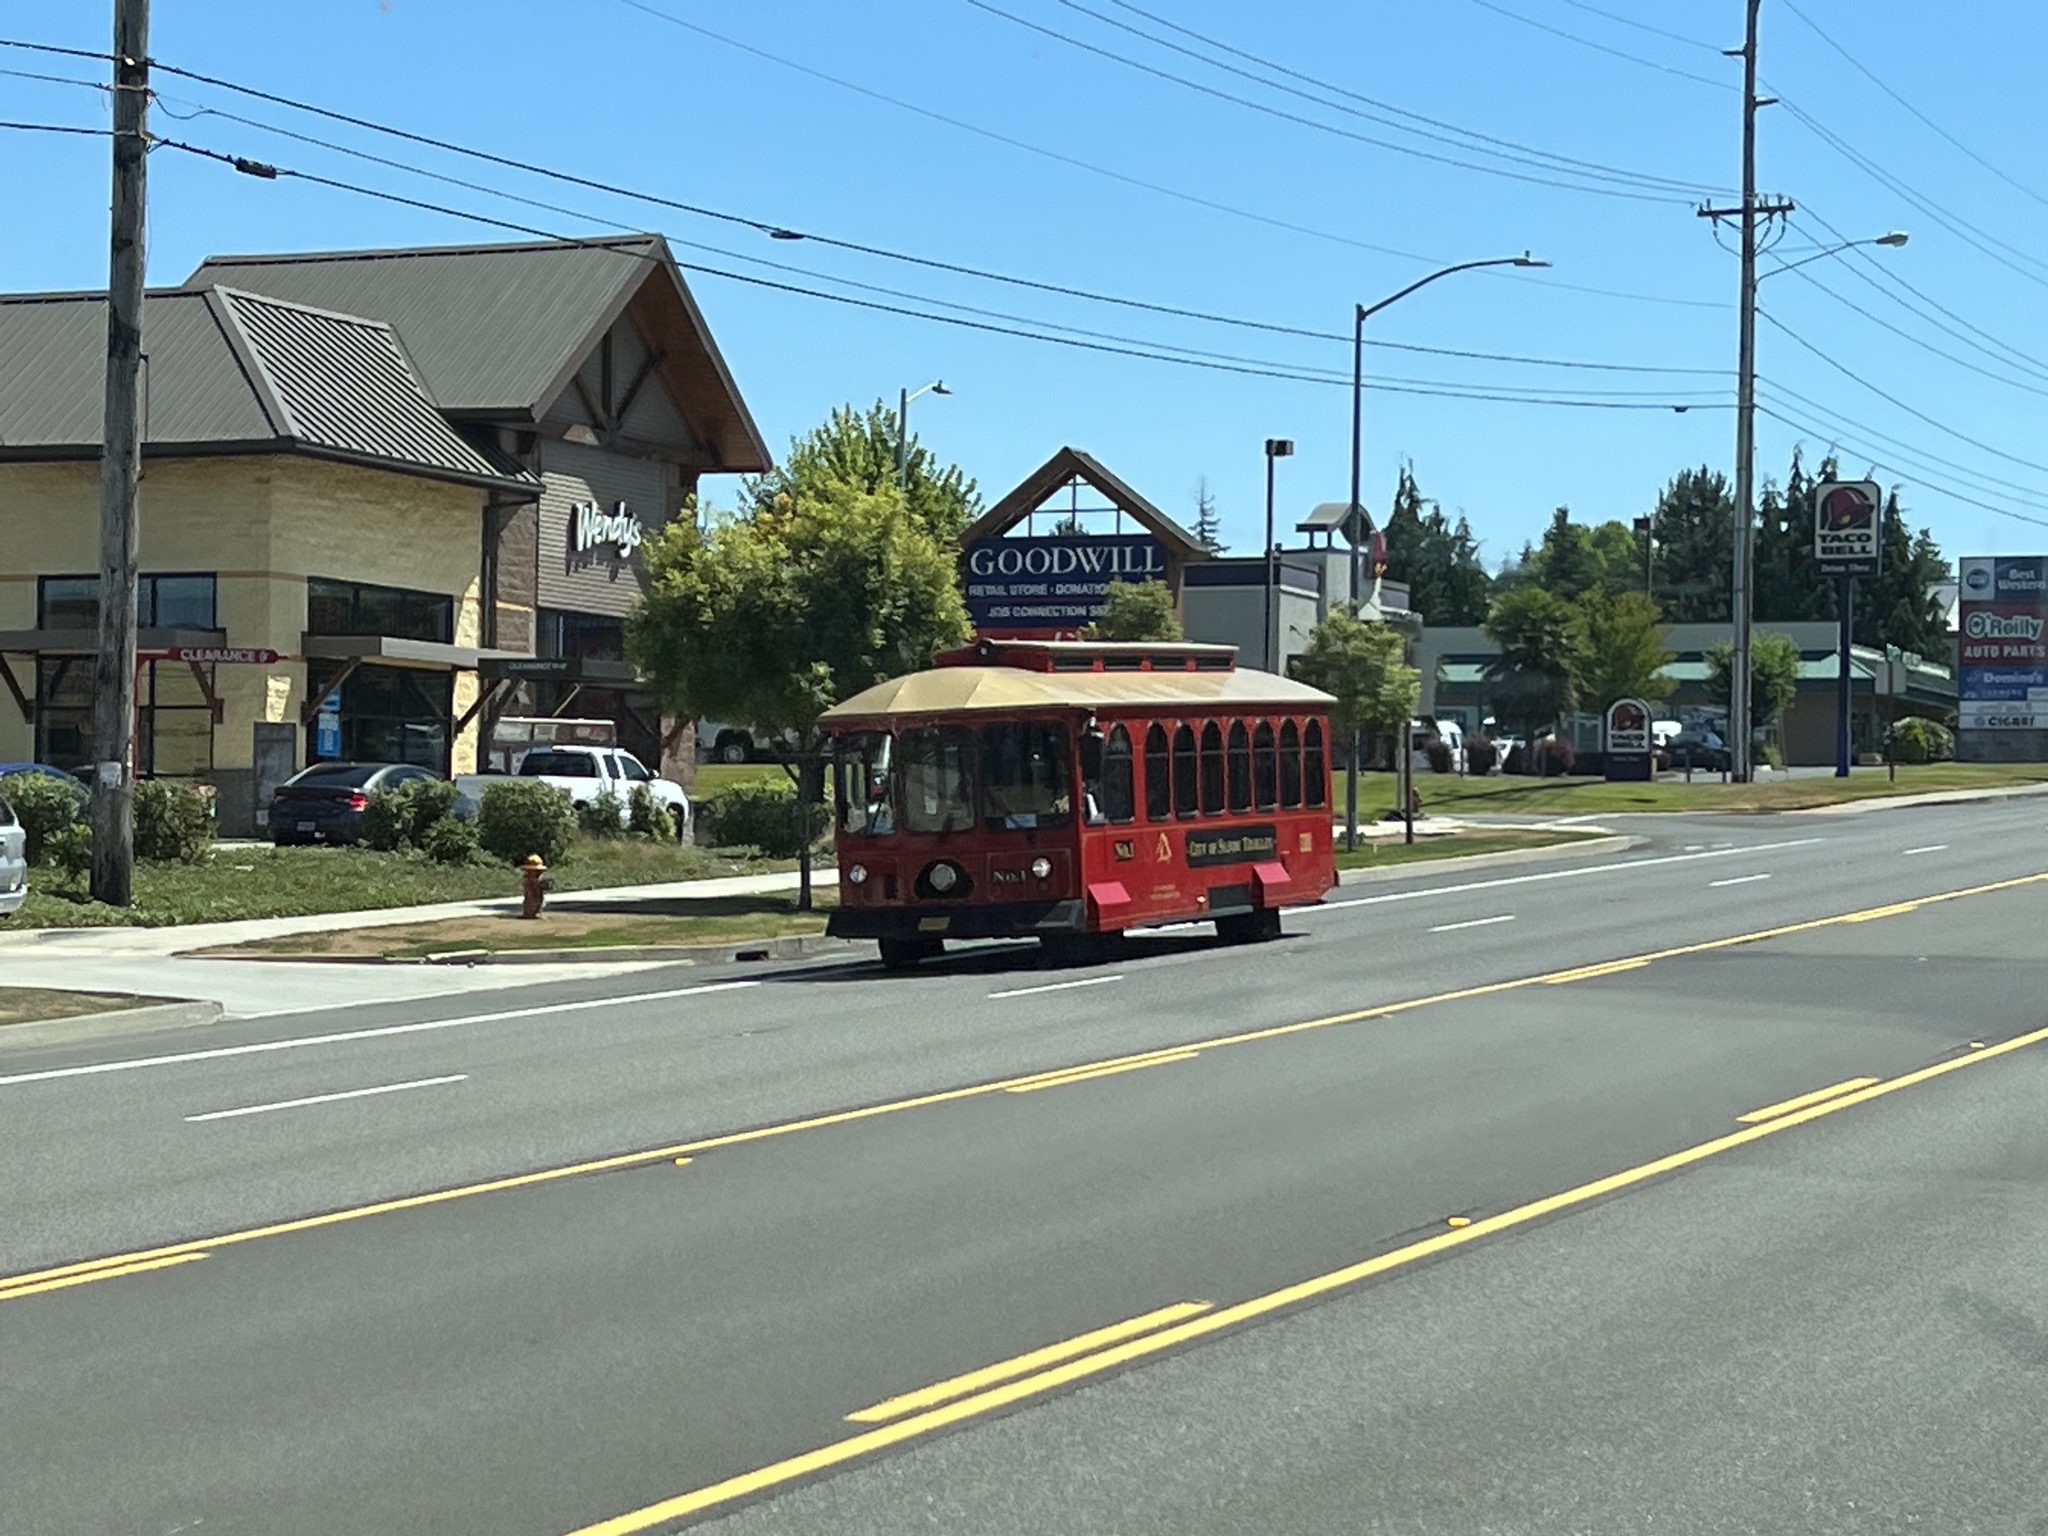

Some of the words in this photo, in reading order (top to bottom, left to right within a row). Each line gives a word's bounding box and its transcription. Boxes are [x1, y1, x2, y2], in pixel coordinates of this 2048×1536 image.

[576, 501, 642, 558] Wendy's
[1817, 533, 1872, 543] TACO
[1820, 545, 1872, 555] BELL
[970, 546, 1164, 576] GOODWILL
[2008, 569, 2035, 580] Best
[1009, 584, 1048, 596] STORE
[1997, 580, 2046, 590] Western
[1967, 612, 2043, 639] O'Reilly
[180, 648, 256, 661] CLEARANCE
[1964, 645, 1999, 658] AUTO
[2003, 645, 2046, 658] PARTS
[1983, 671, 2044, 684] Domino's
